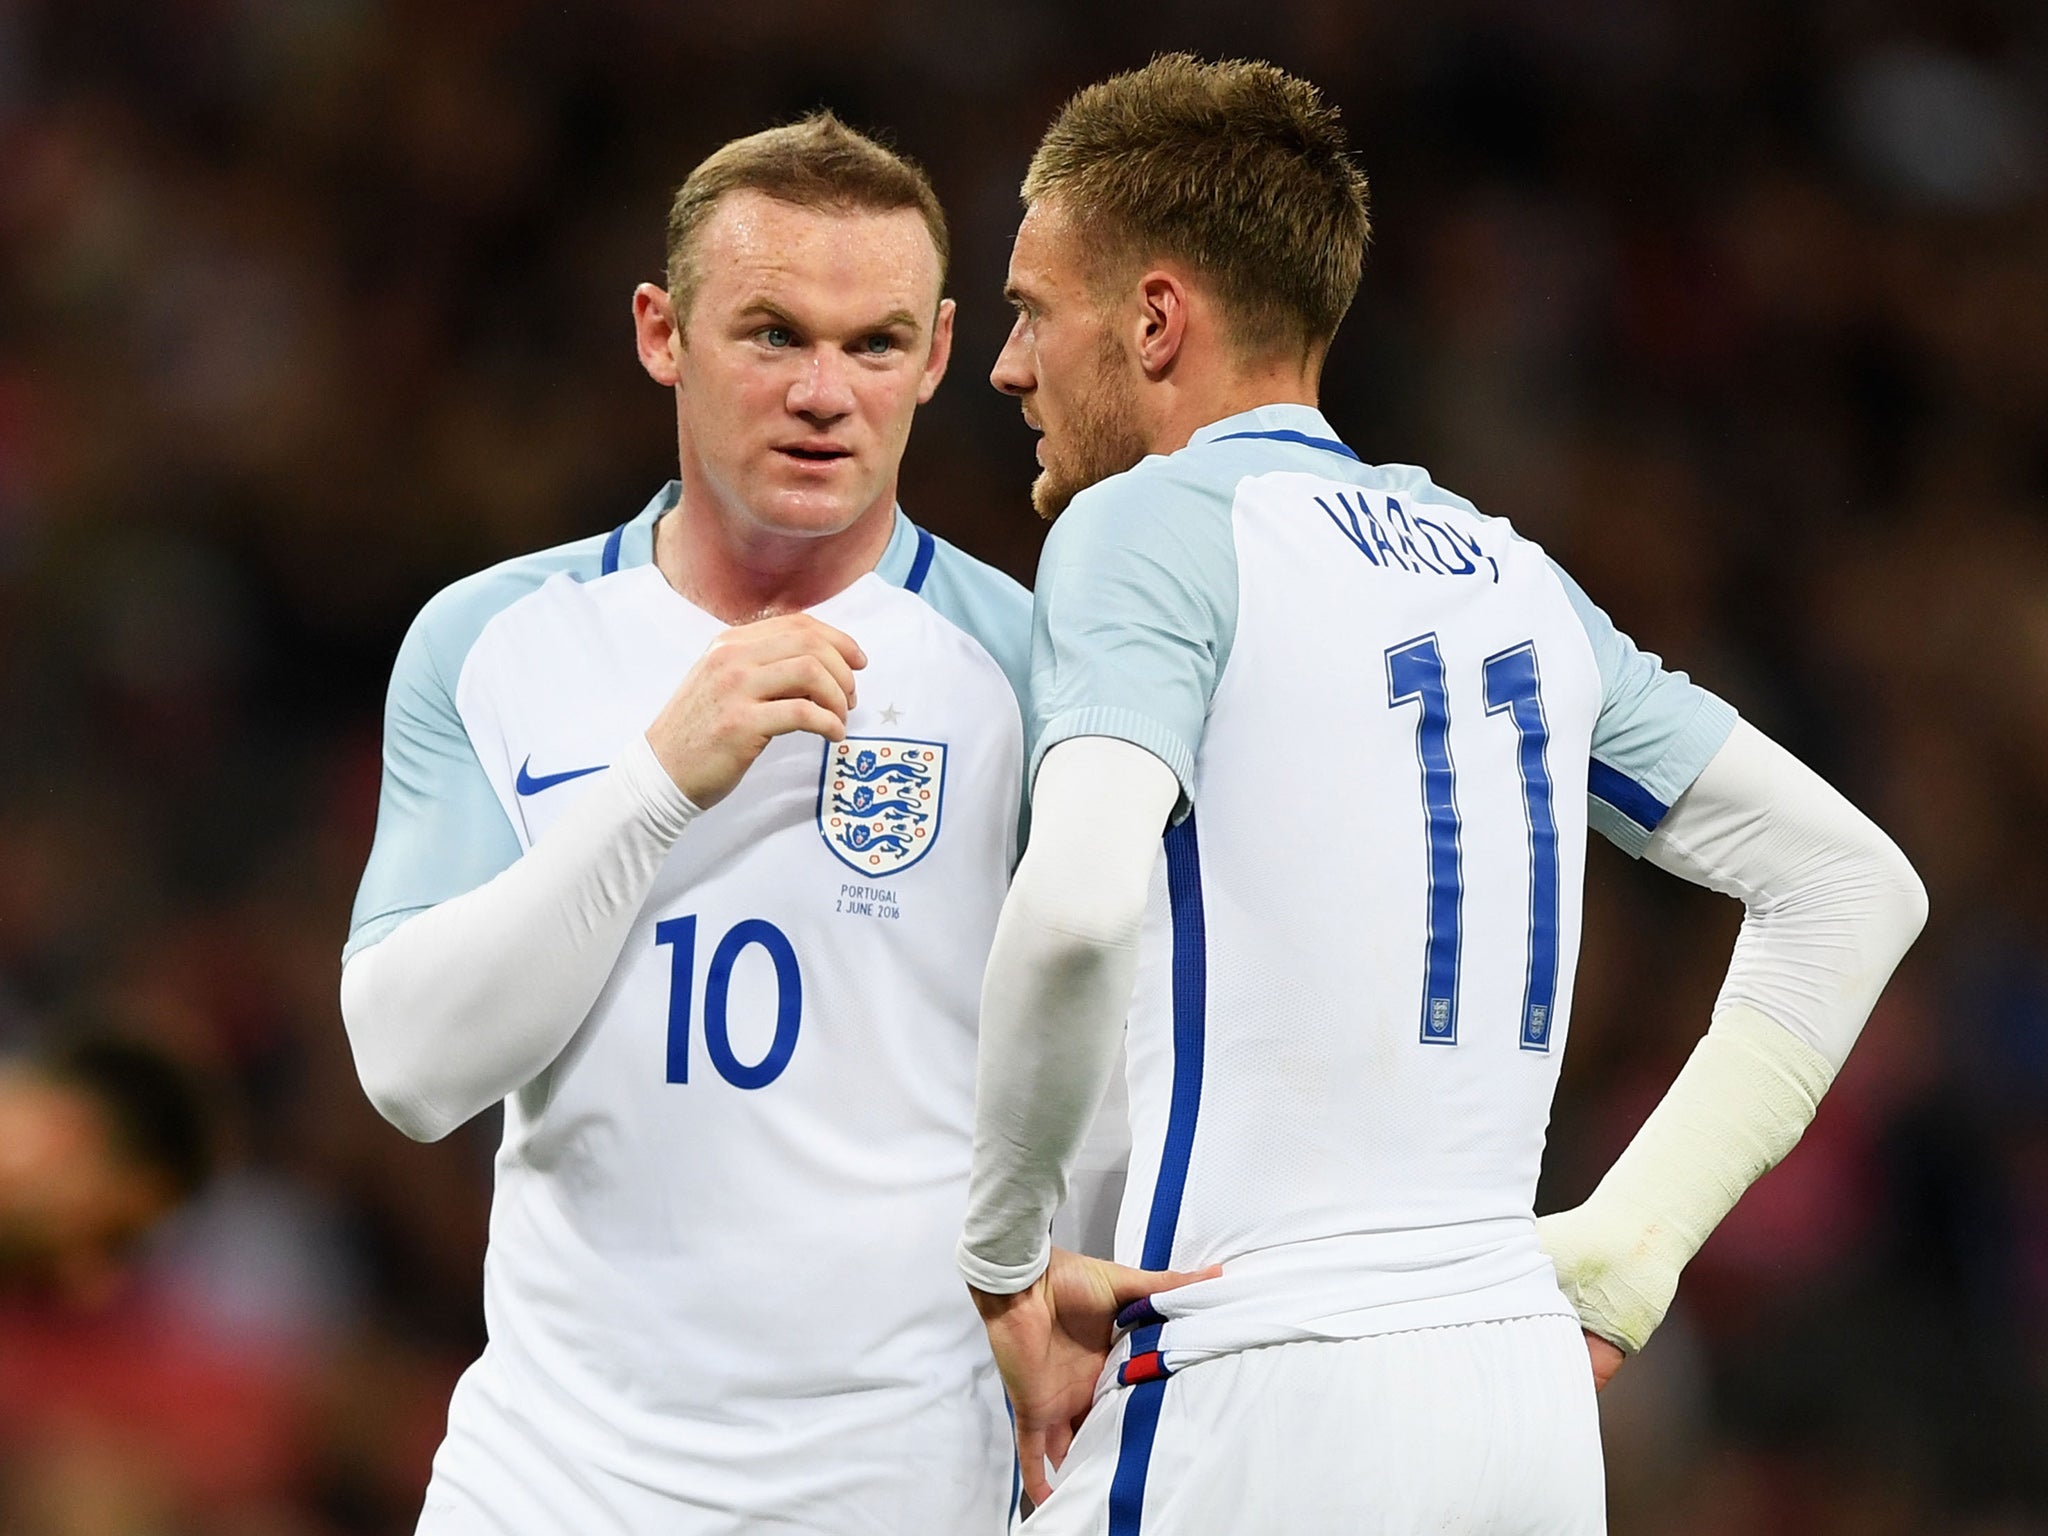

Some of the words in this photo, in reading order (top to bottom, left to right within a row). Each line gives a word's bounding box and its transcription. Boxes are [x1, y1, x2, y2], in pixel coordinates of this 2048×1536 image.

[1313, 491, 1499, 584] VARDY
[1384, 631, 1561, 1053] 11
[836, 899, 842, 912] 2
[846, 901, 873, 916] JUNE
[878, 904, 900, 919] 2016
[841, 884, 897, 903] PORTUGAL
[655, 914, 802, 1090] 10
